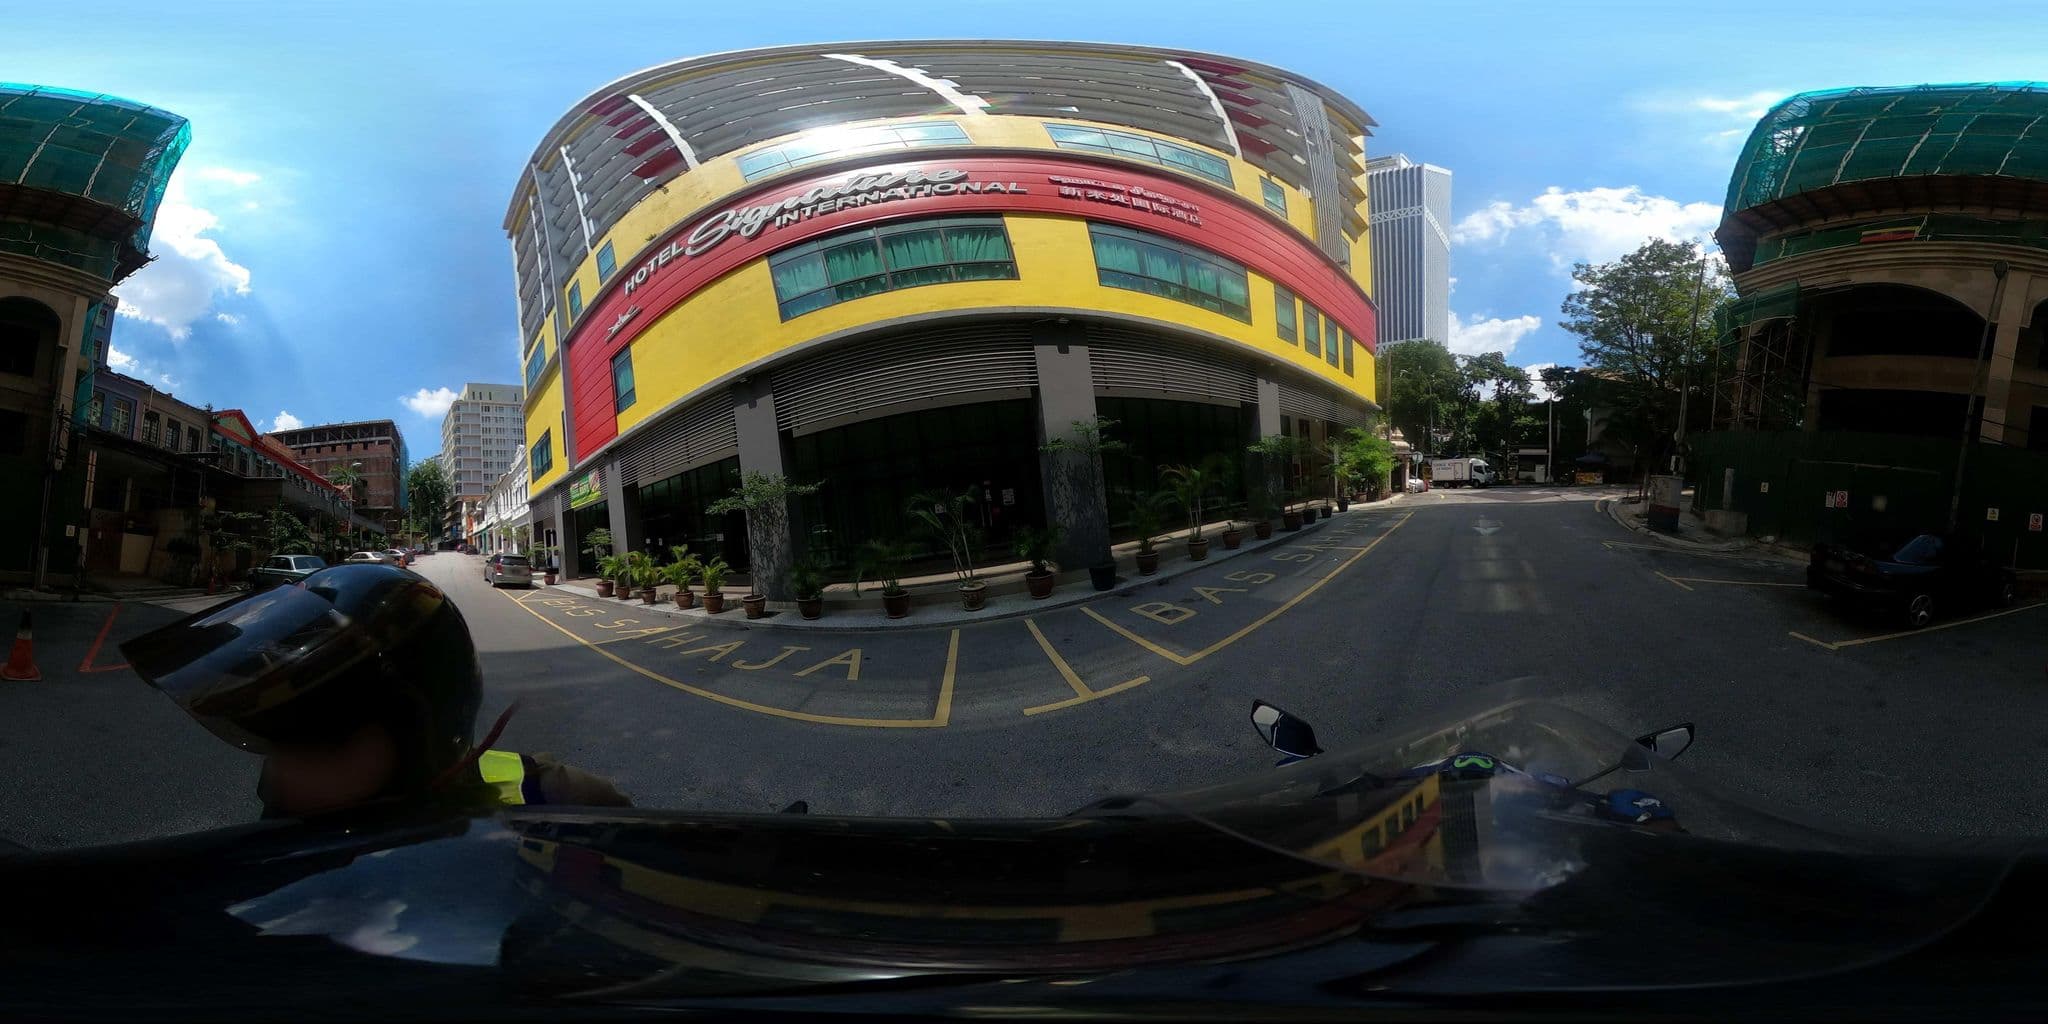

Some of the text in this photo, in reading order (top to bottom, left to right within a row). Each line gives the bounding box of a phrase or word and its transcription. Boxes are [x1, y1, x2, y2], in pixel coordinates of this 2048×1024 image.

[624, 241, 684, 296] HOTEL
[685, 167, 968, 256] Signature
[775, 181, 1028, 229] INTERNATIONAL
[1129, 570, 1277, 626] BAS
[594, 618, 864, 680] SAHAJA
